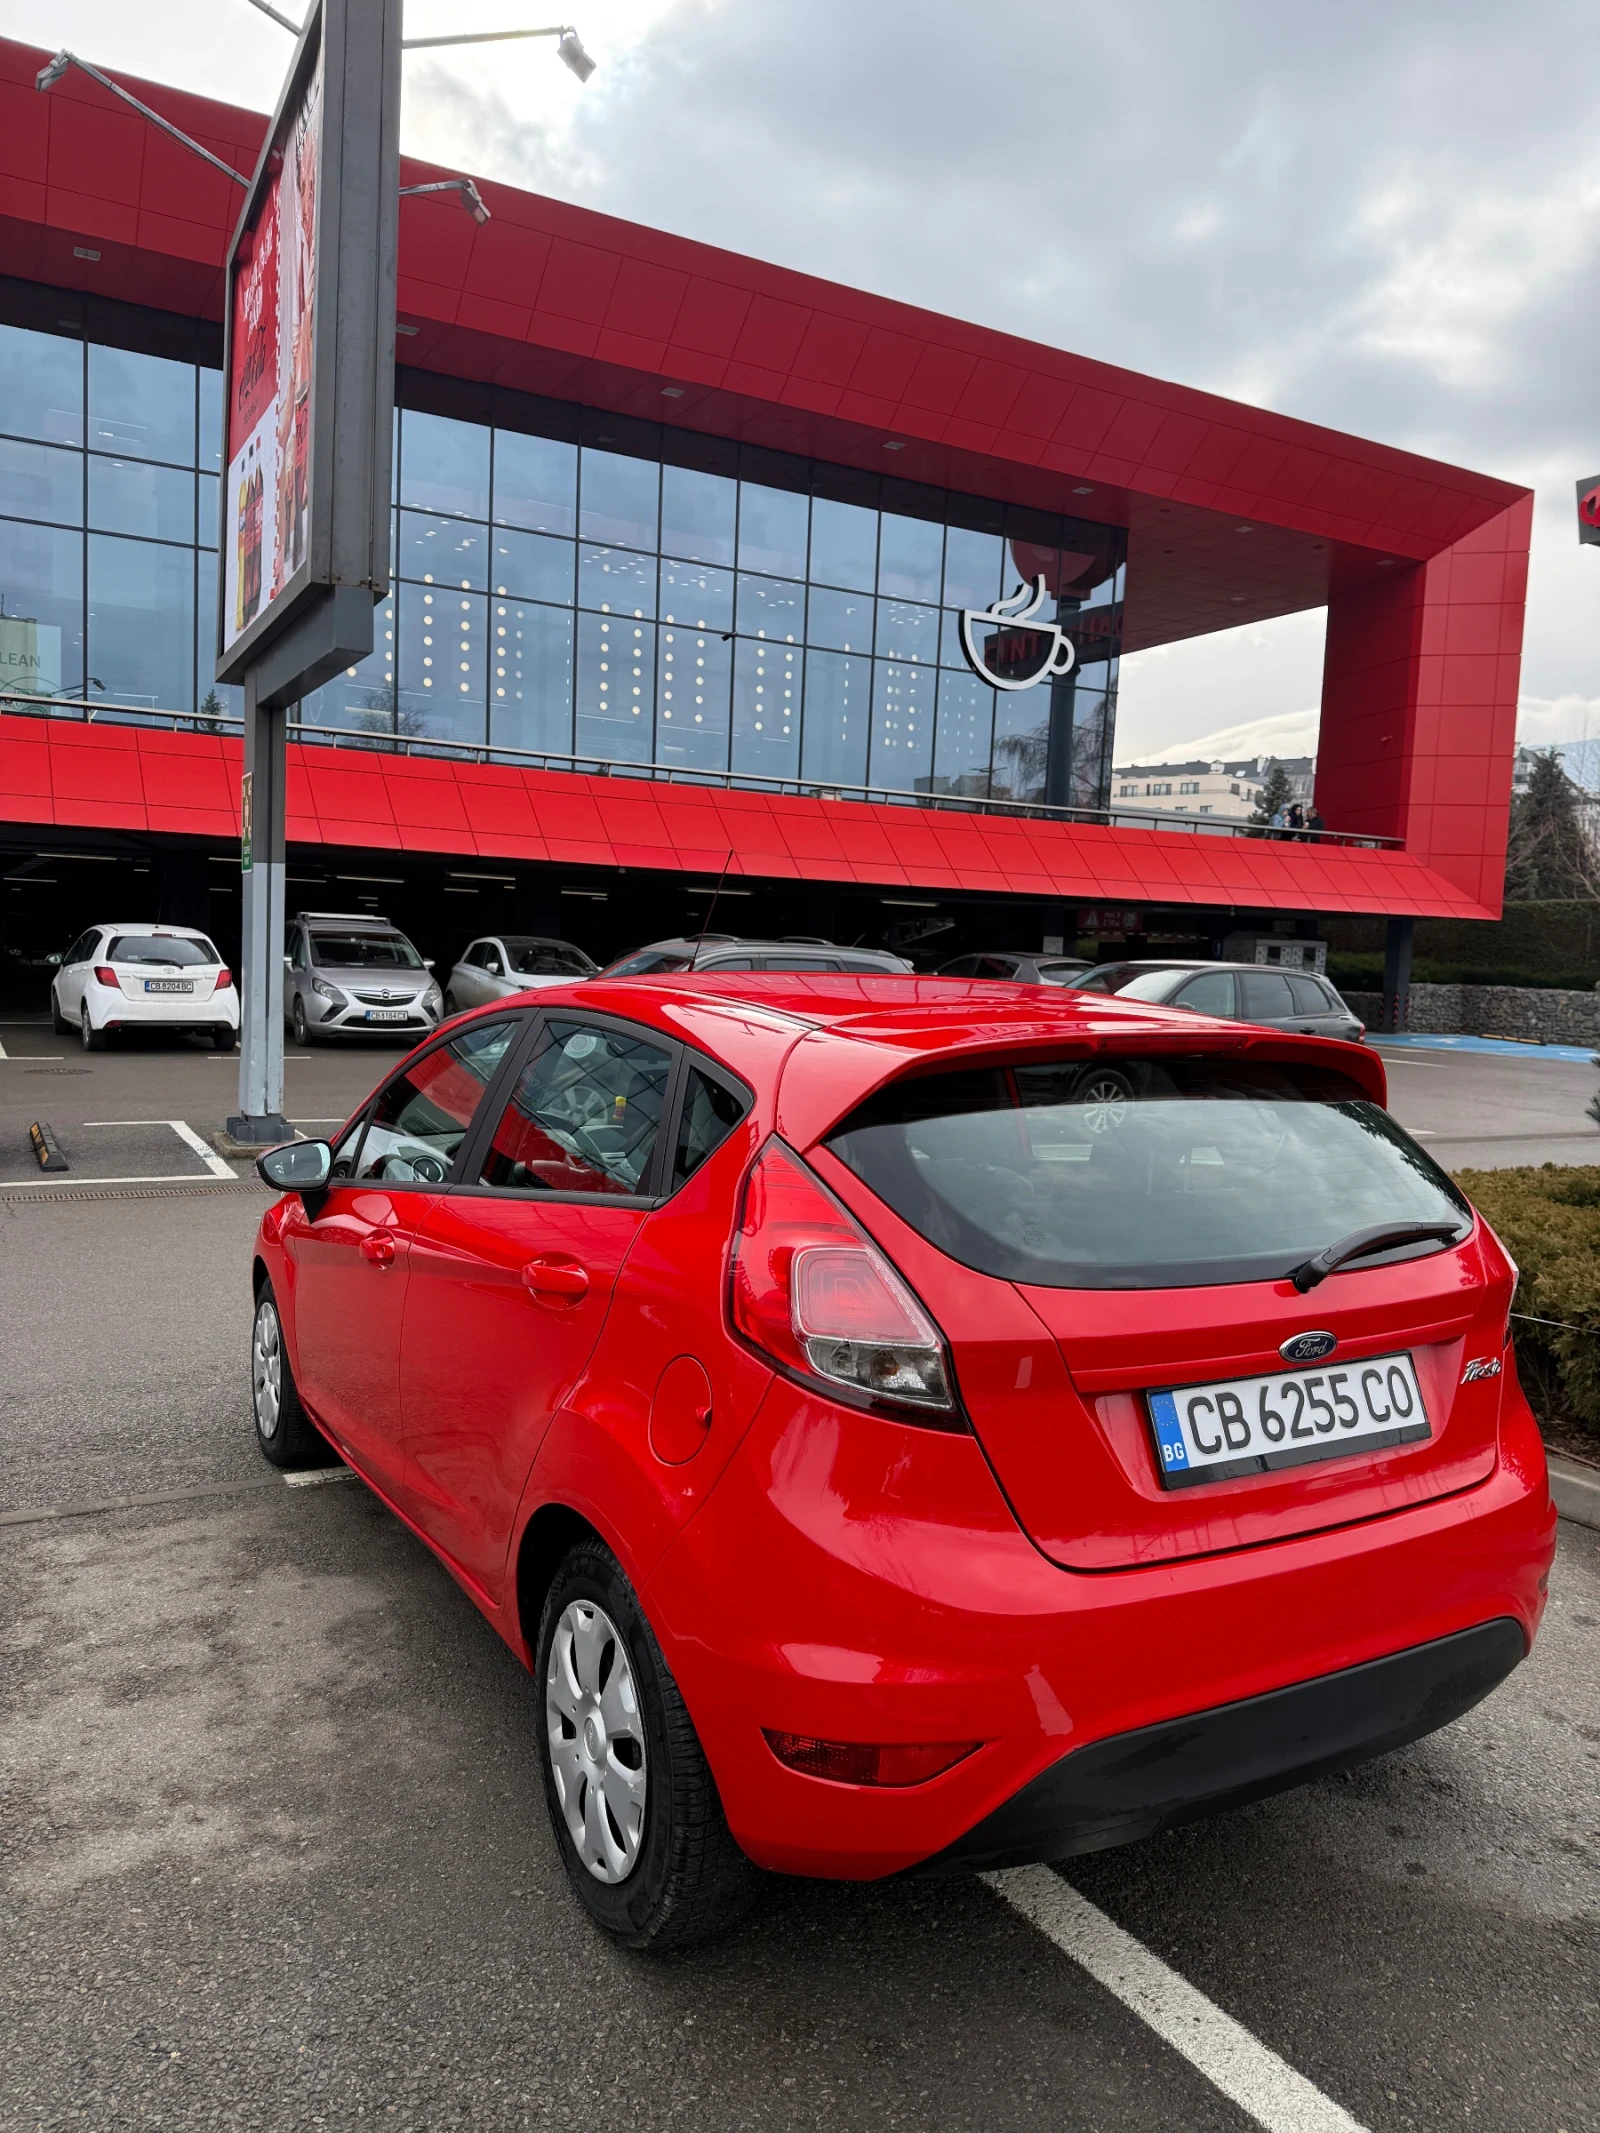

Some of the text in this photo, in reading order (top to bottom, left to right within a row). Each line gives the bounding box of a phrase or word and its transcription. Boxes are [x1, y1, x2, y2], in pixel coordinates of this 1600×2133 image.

[150, 981, 160, 990] CB
[1294, 1337, 1328, 1358] Ford
[1460, 1356, 1501, 1385] Fiesta
[1186, 1365, 1414, 1455] CB 6255 CO
[1162, 1442, 1185, 1462] BG
